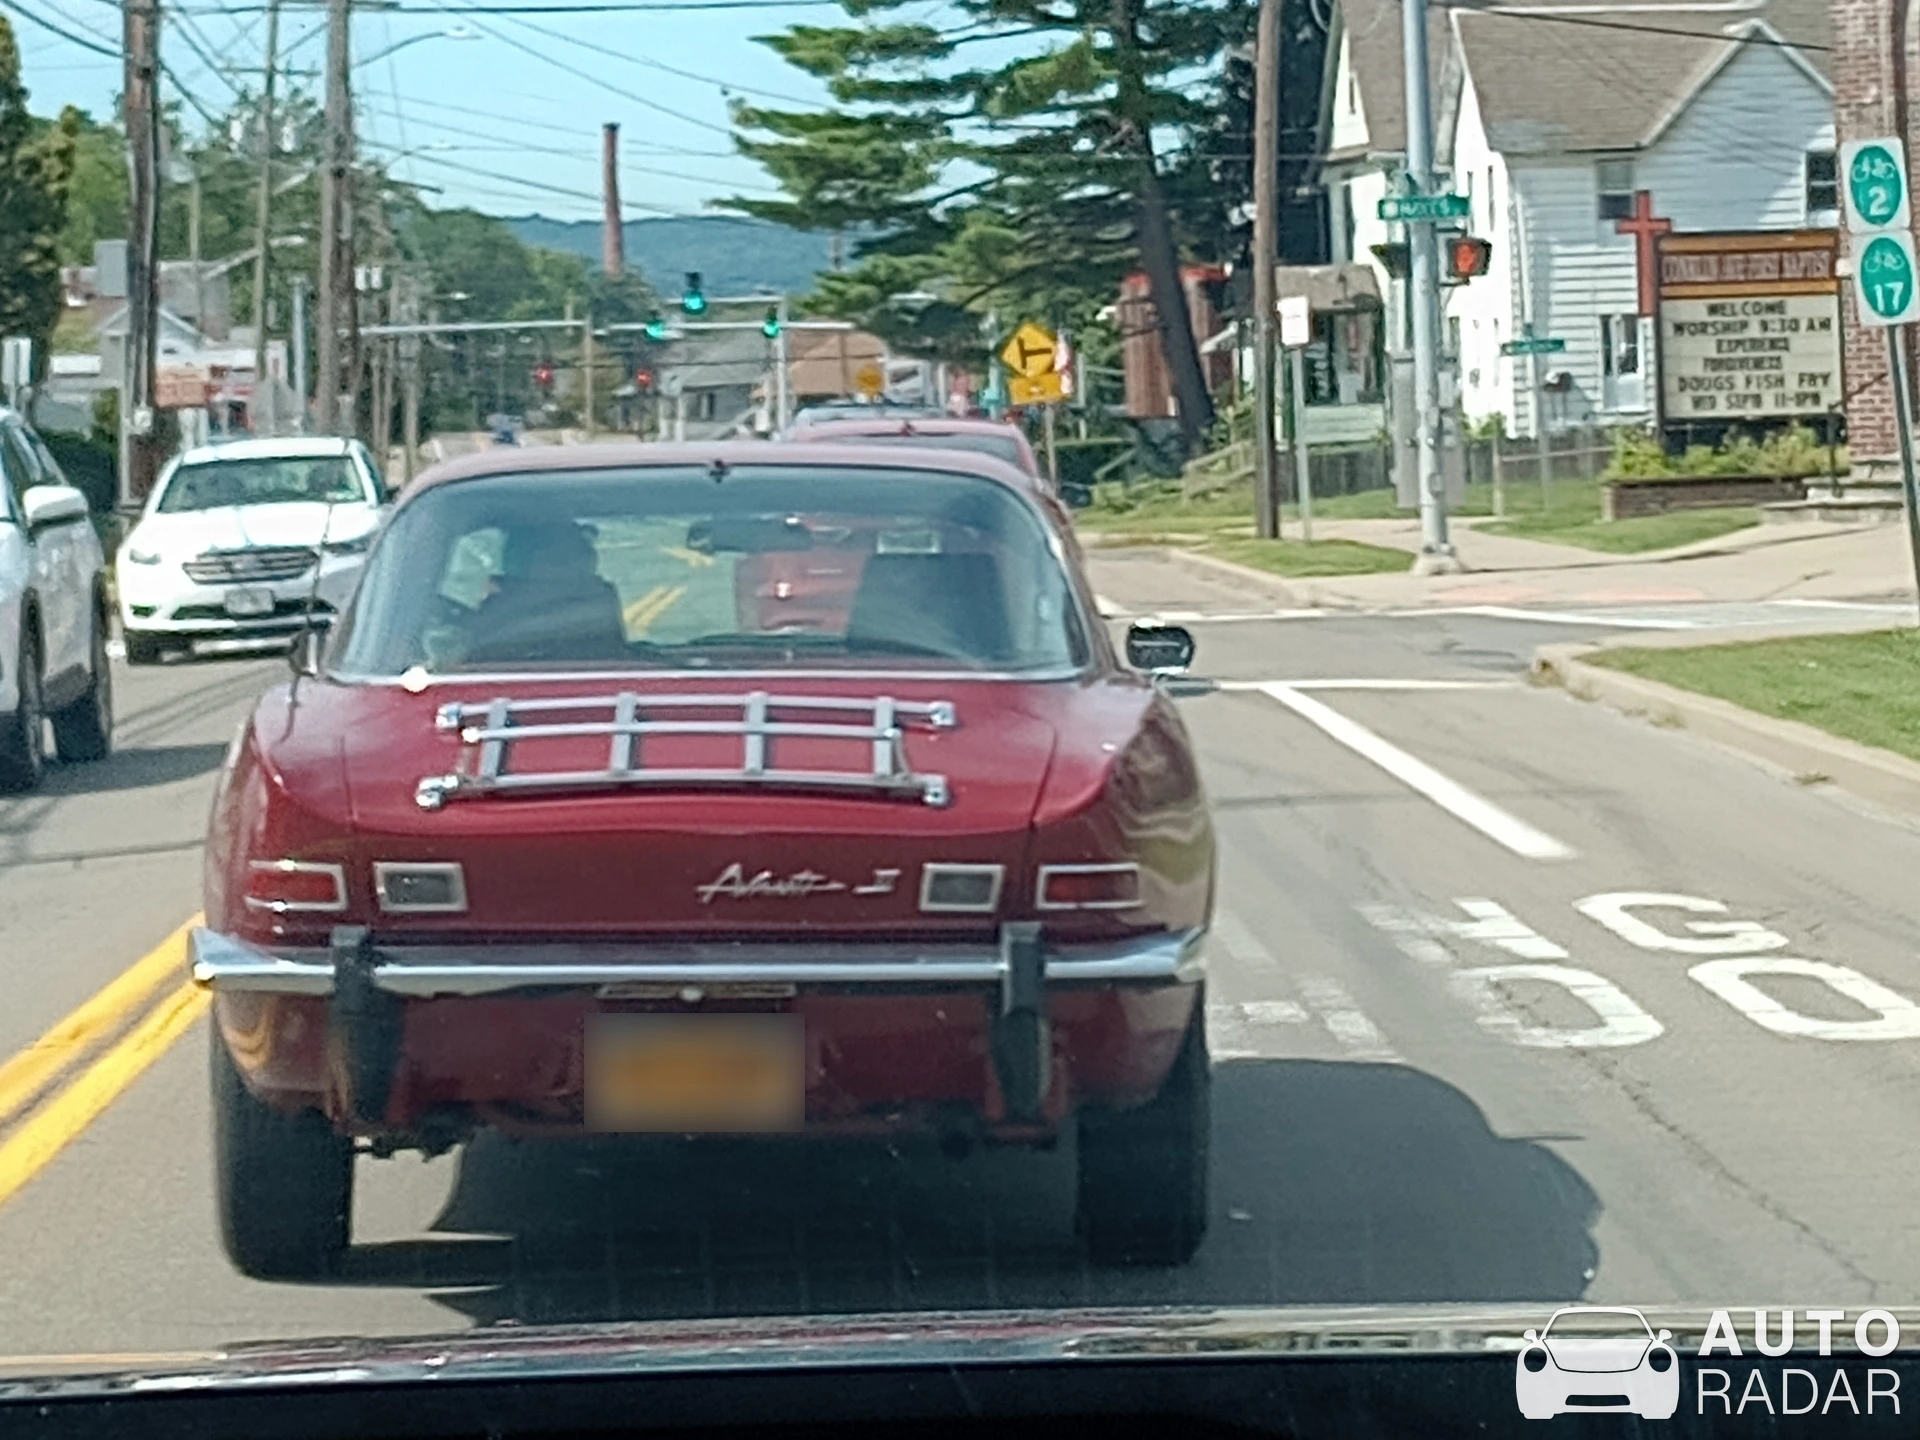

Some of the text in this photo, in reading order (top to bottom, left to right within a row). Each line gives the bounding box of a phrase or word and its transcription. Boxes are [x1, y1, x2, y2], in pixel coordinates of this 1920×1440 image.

[1868, 185, 1890, 216] 2
[1873, 281, 1904, 313] 17
[1707, 301, 1787, 317] WELCOME
[1673, 320, 1749, 336] WORSHIP
[1806, 317, 1832, 332] AM
[1678, 372, 1831, 392] DOUGS FISH FRY
